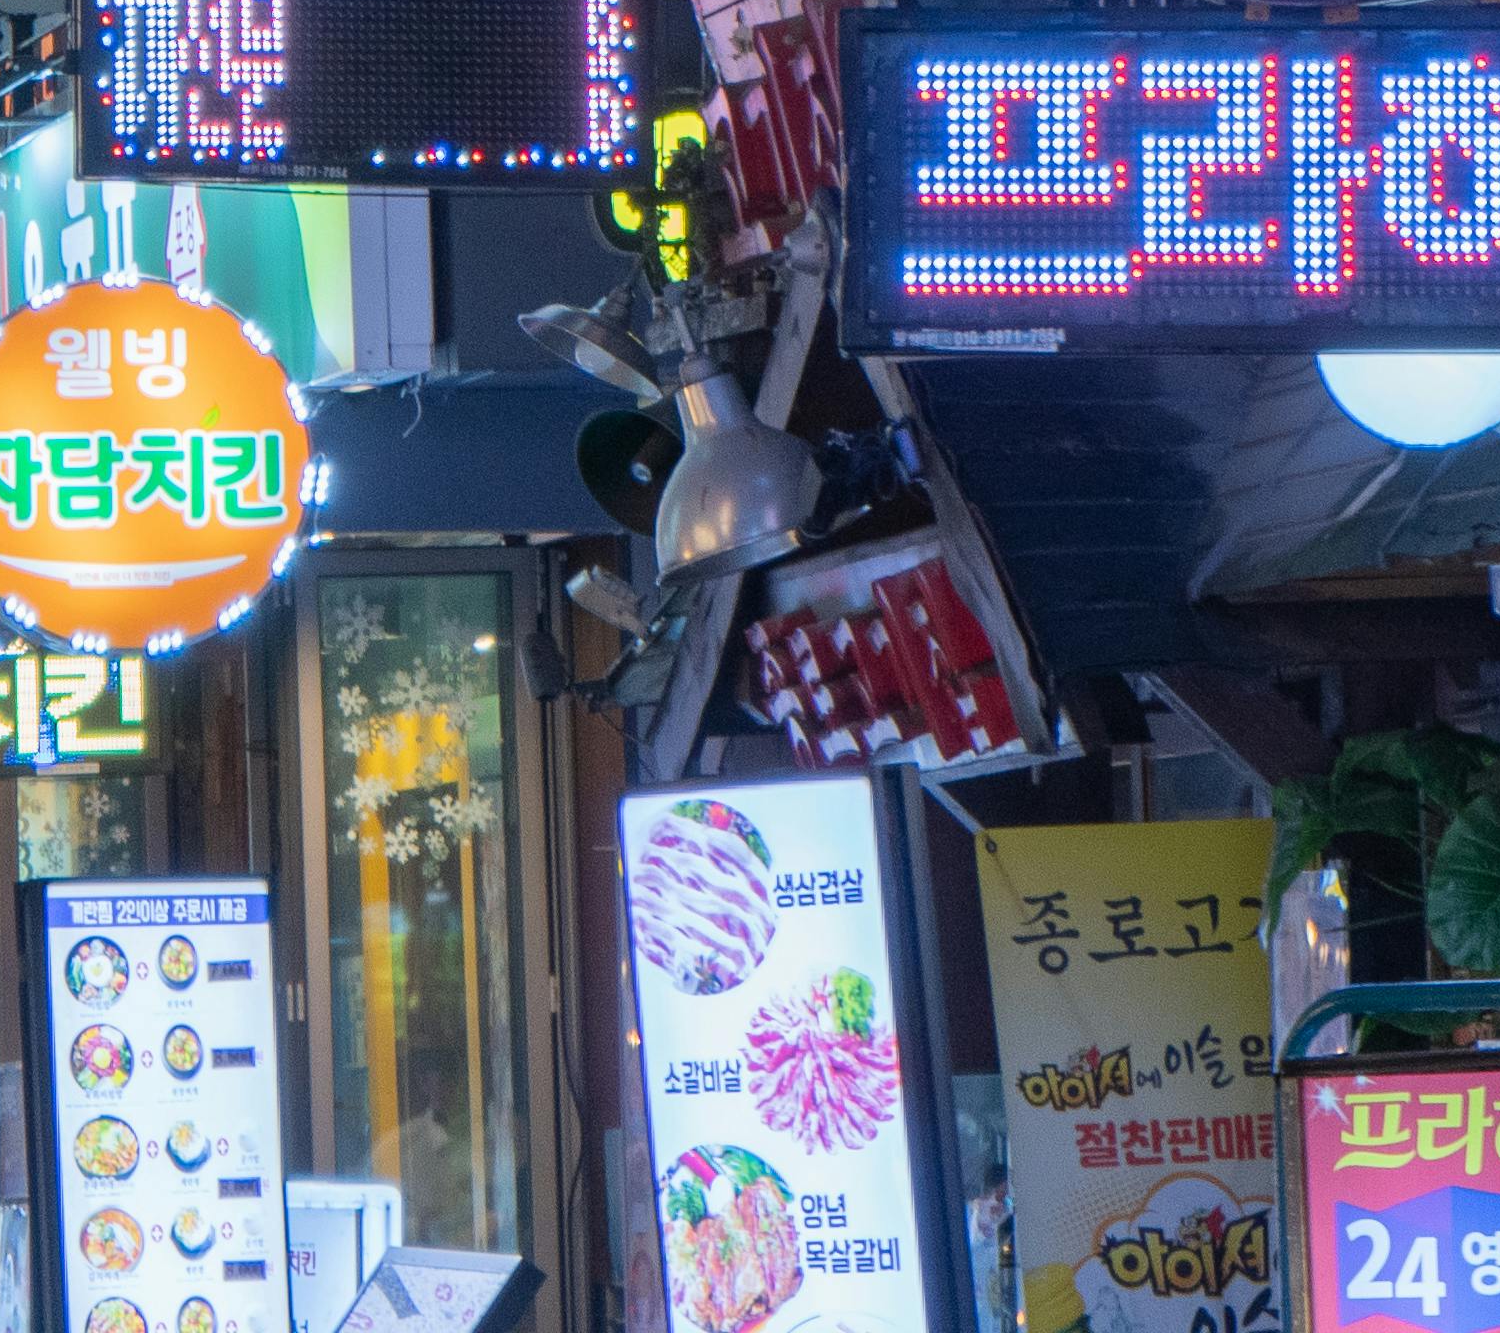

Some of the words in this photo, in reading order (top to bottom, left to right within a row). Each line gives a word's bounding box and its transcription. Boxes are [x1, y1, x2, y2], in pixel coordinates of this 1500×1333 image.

[45, 324, 189, 400] 웰빙
[773, 866, 866, 910] 생삼겹살
[116, 899, 170, 925] 2인이상
[172, 898, 215, 922] 주문시
[218, 898, 248, 922] 제공
[662, 1056, 744, 1099] 소갈비살
[1164, 1023, 1236, 1090] 이슬
[799, 1191, 849, 1232] 양념
[803, 1235, 902, 1278] 목살갈비
[1345, 1217, 1448, 1318] 24
